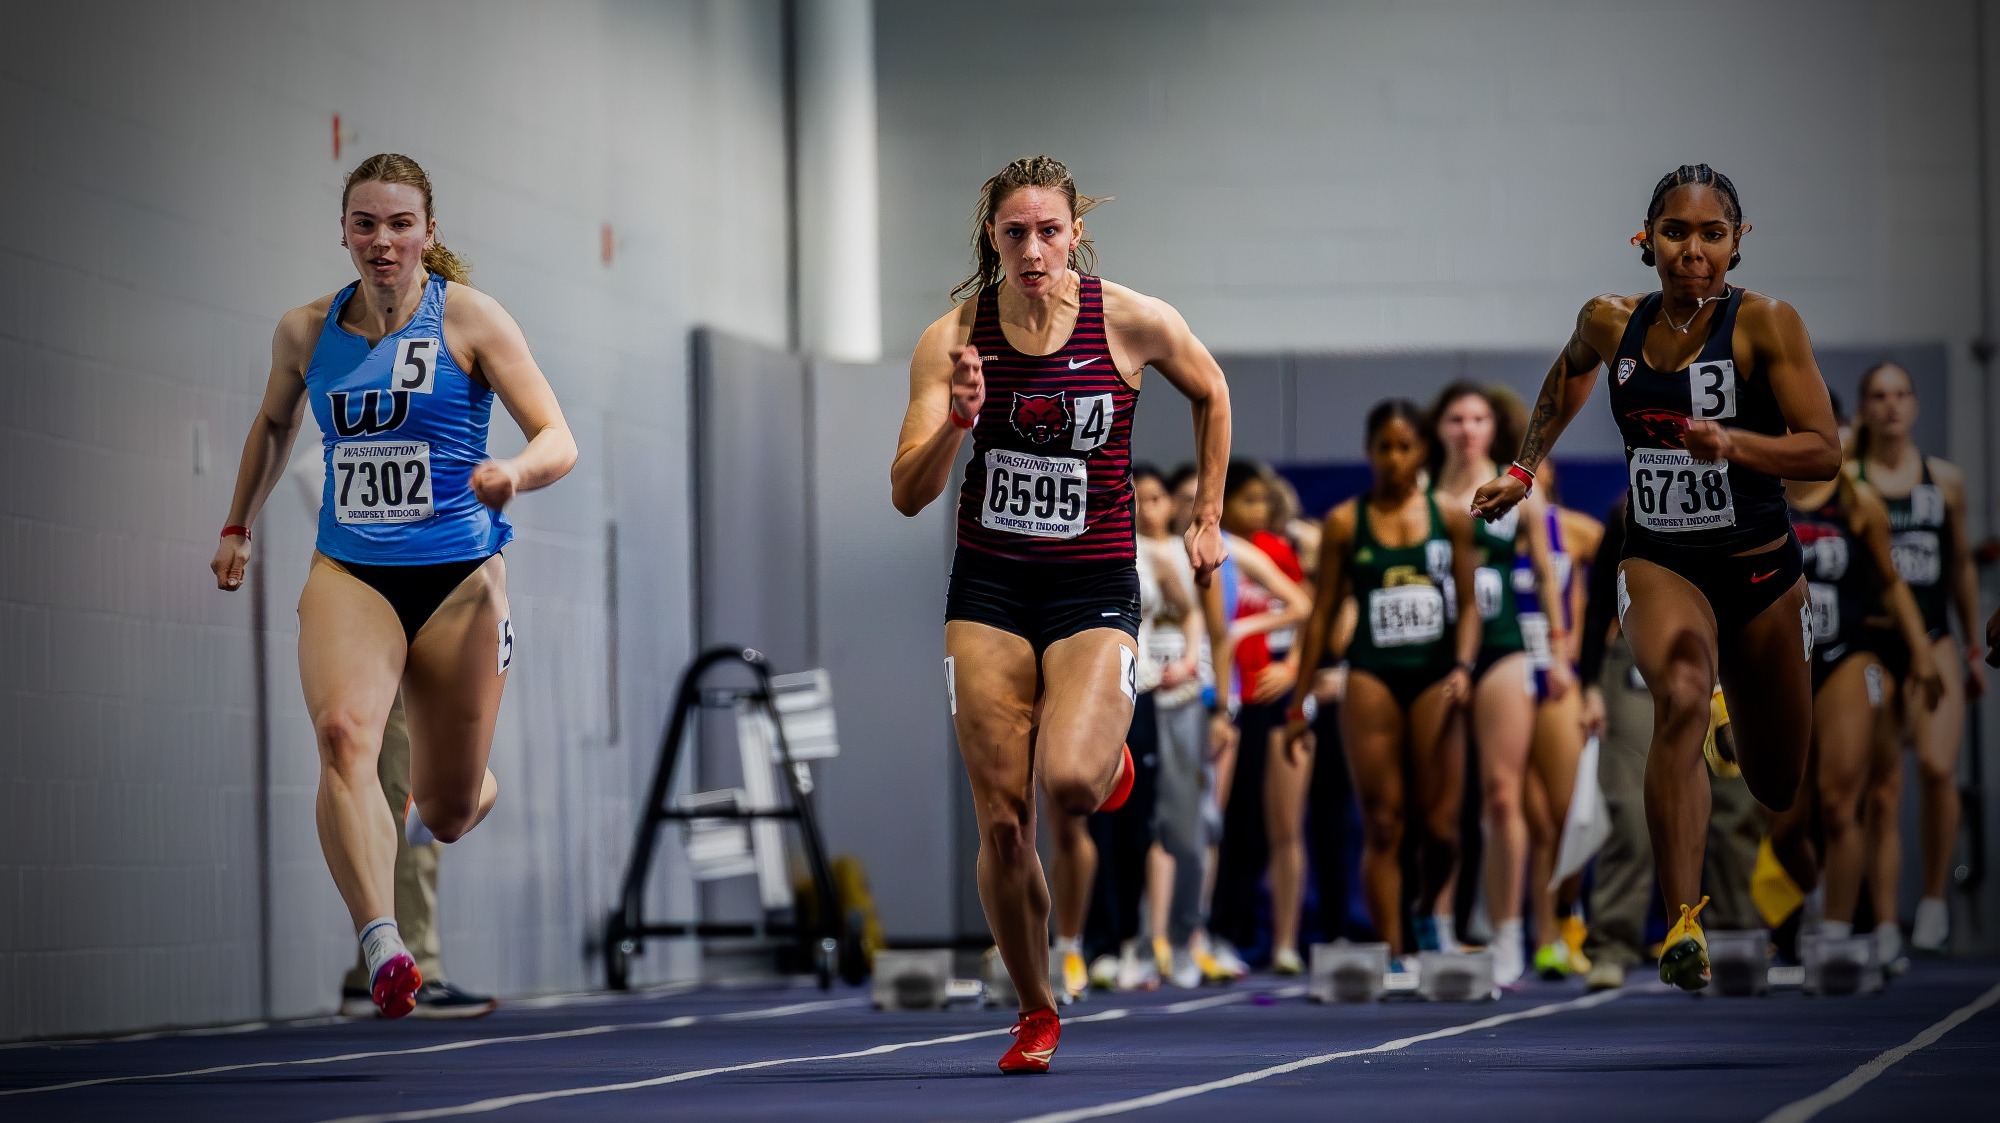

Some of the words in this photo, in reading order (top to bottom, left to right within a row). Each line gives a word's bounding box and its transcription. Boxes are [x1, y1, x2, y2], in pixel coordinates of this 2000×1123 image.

[401, 341, 430, 389] 5
[326, 389, 410, 437] W
[1700, 364, 1726, 417] 3
[1080, 399, 1106, 446] 4
[343, 446, 419, 457] WASHINGTON
[996, 453, 1075, 473] WASHINGTON
[337, 460, 428, 507] 7302
[989, 468, 1082, 521] 6595
[1636, 469, 1726, 514] 6738
[387, 509, 421, 517] INDOOR
[995, 516, 1033, 530] DEMPSEY
[1036, 523, 1070, 533] INDOOR
[1647, 517, 1684, 527] DEMPSEY
[1686, 515, 1721, 526] INDOOR
